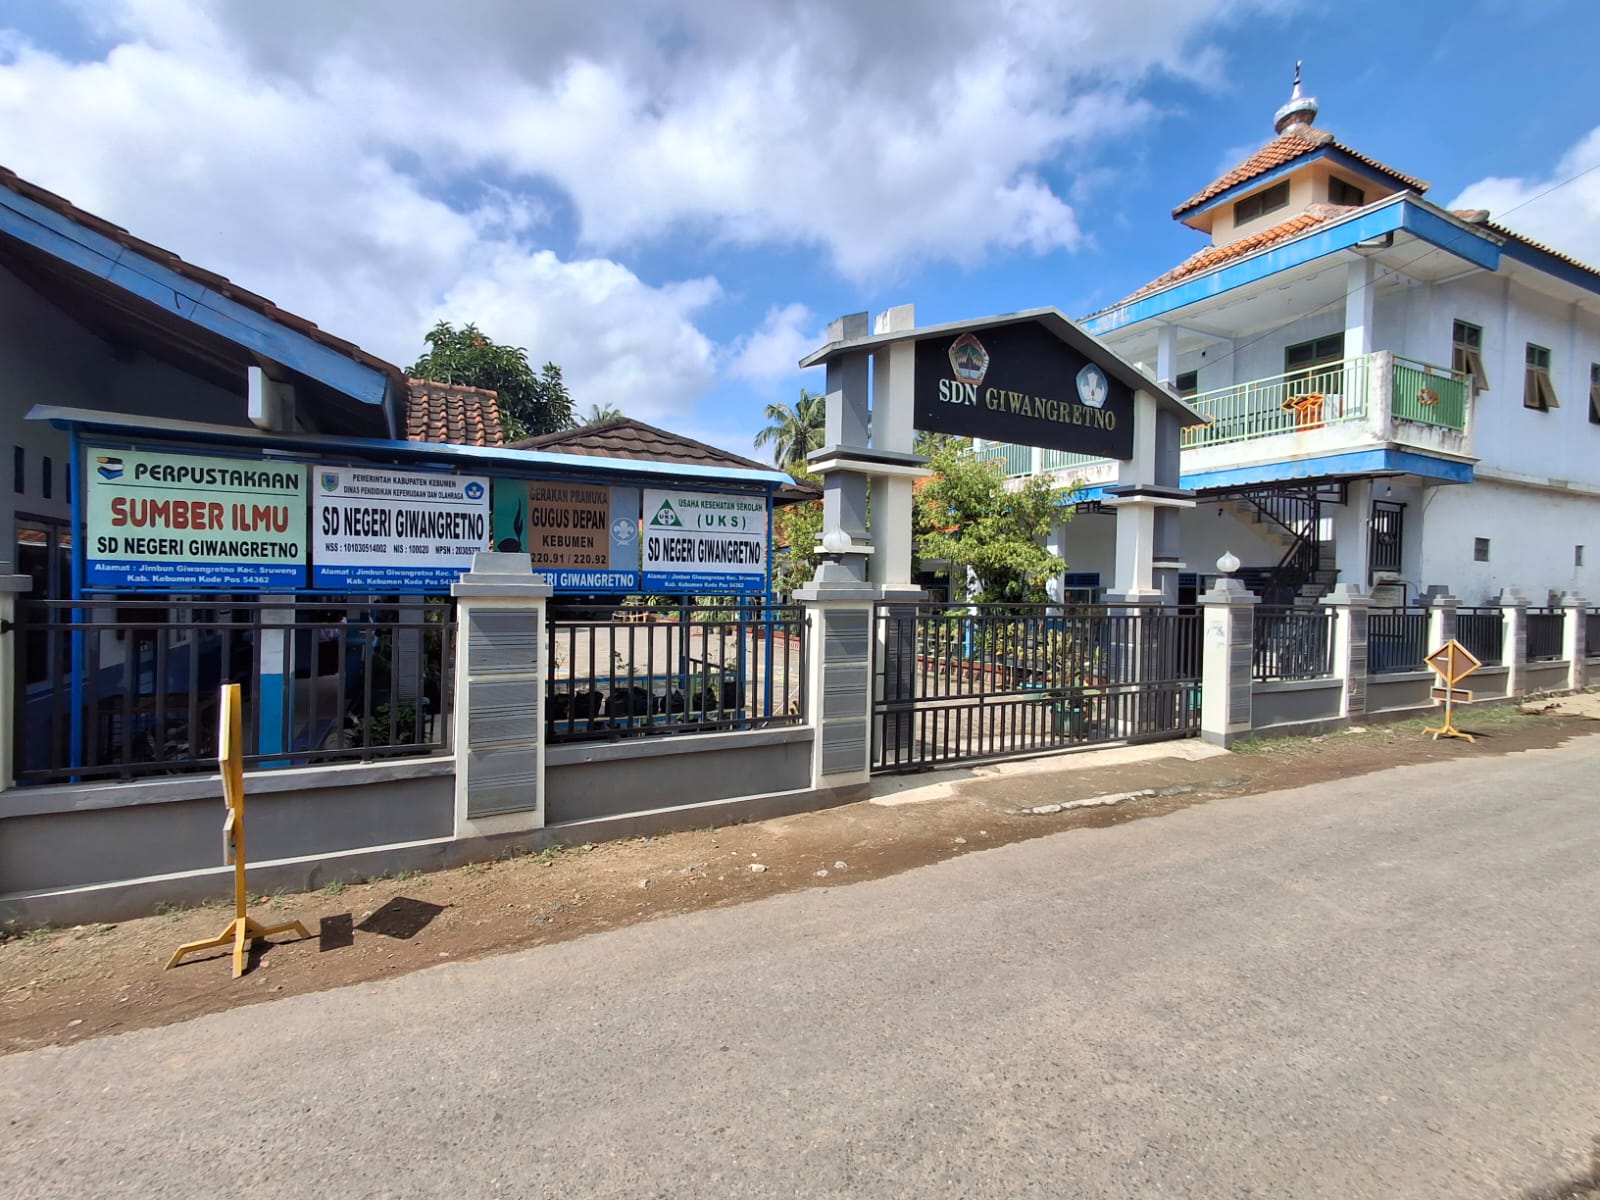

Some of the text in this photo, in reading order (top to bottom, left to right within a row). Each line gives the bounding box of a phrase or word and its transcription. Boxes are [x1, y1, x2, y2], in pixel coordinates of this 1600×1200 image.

[939, 378, 1116, 431] SDN GIWANGRETNO
[134, 463, 299, 490] PERPUSTAKAAN
[352, 474, 456, 488] PEMERINTAH KABUPATEN KEBUMEN
[344, 486, 359, 494] DINAS
[361, 486, 391, 496] PENDIDIKAN
[392, 488, 426, 498] KEPEMUDAAN
[438, 491, 464, 500] OLAHRAGA
[530, 487, 608, 504] GERAKAN PRAMUKA
[679, 499, 763, 512] USAHA KESEHATAN SEKOLAH
[111, 497, 289, 532] SUMBER ILMU
[532, 507, 606, 530] GUGUS DEPAN
[322, 506, 484, 541] SD NEGERI GIWANGRETNO
[97, 536, 299, 558] SD NEGERI GIWANGRETNO
[325, 542, 338, 552] NSS
[393, 544, 404, 553] NIS
[435, 546, 450, 555] NPSN
[542, 535, 594, 548] KEBUMEN
[648, 537, 760, 564] SD NEGERI GIWANGRETNO
[531, 553, 564, 564] 220.91
[574, 553, 606, 564] 220.92
[176, 565, 234, 574] Giwangretno
[560, 573, 634, 587] GIWANGRETNO
